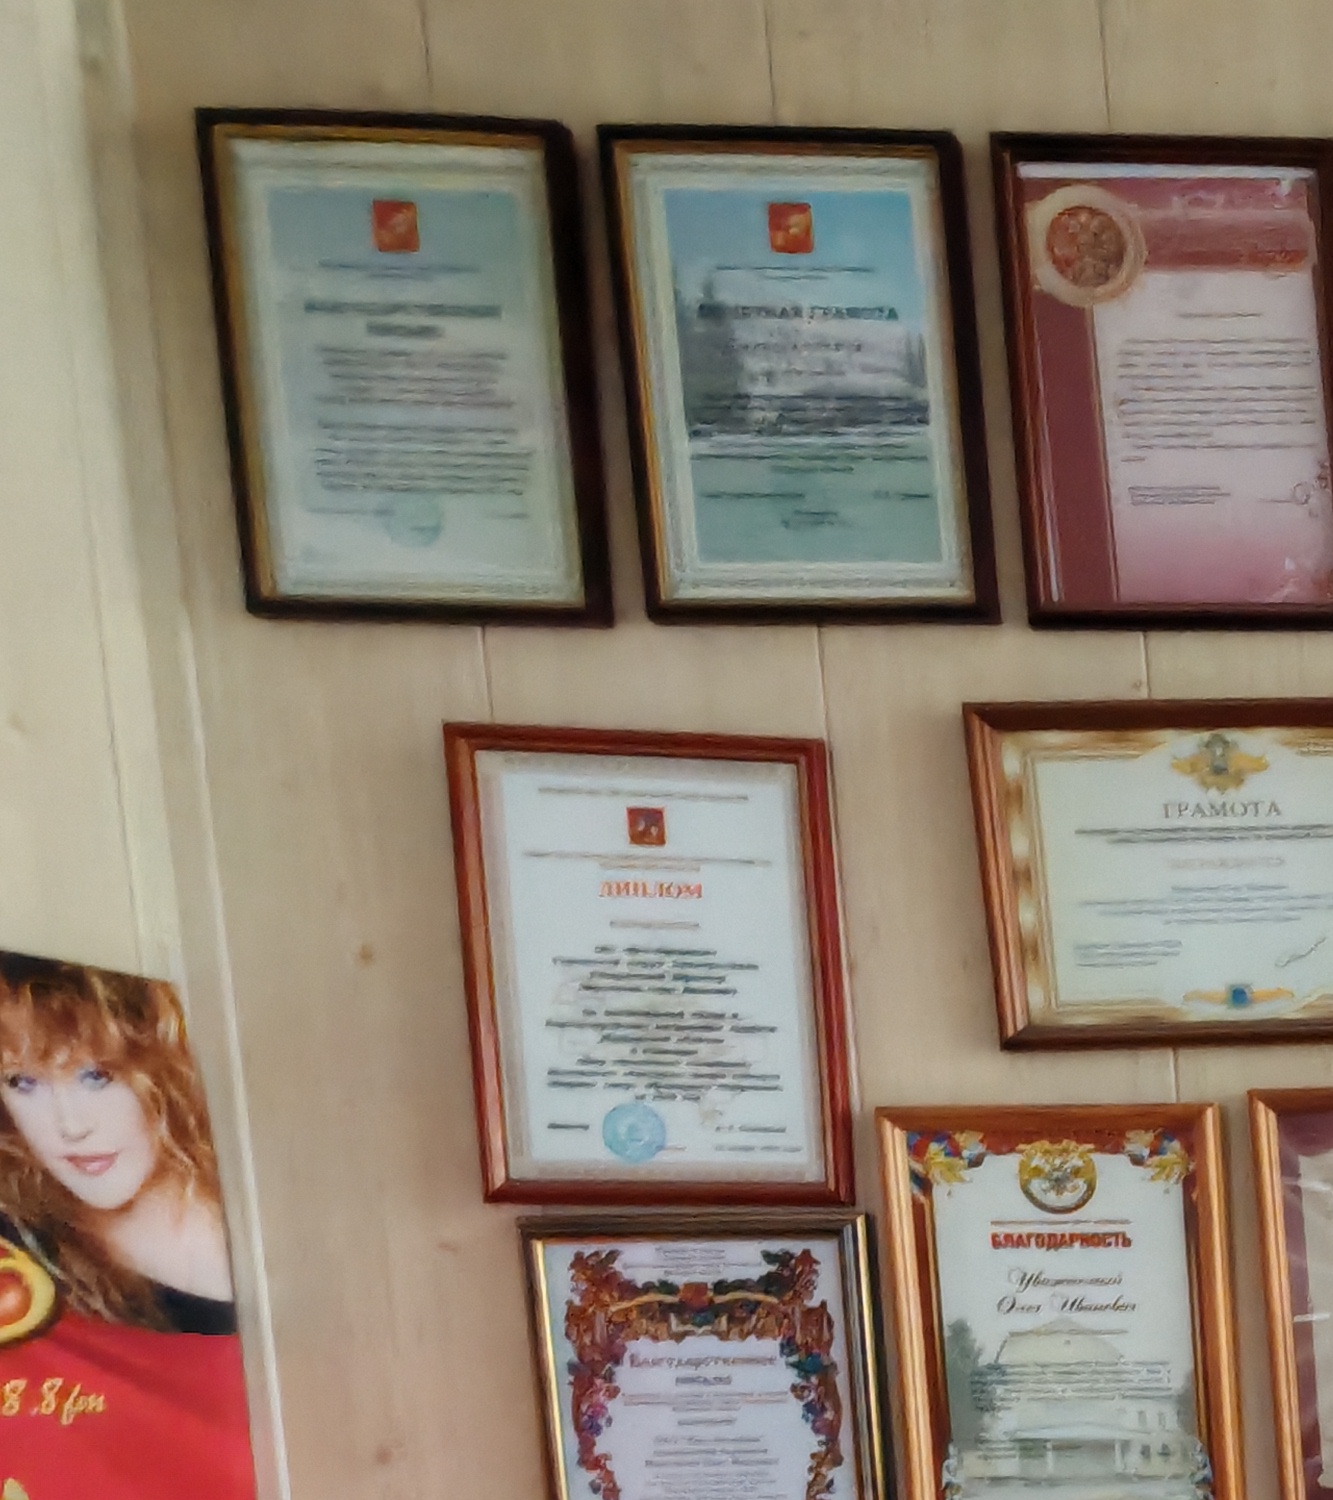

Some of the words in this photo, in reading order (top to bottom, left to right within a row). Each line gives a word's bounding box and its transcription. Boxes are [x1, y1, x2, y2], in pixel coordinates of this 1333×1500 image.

[1163, 800, 1282, 819] ГРАМОТА
[598, 881, 703, 899] ДИПЛОМ
[990, 1231, 1133, 1250] БЛАГОДАРНОСТЬ
